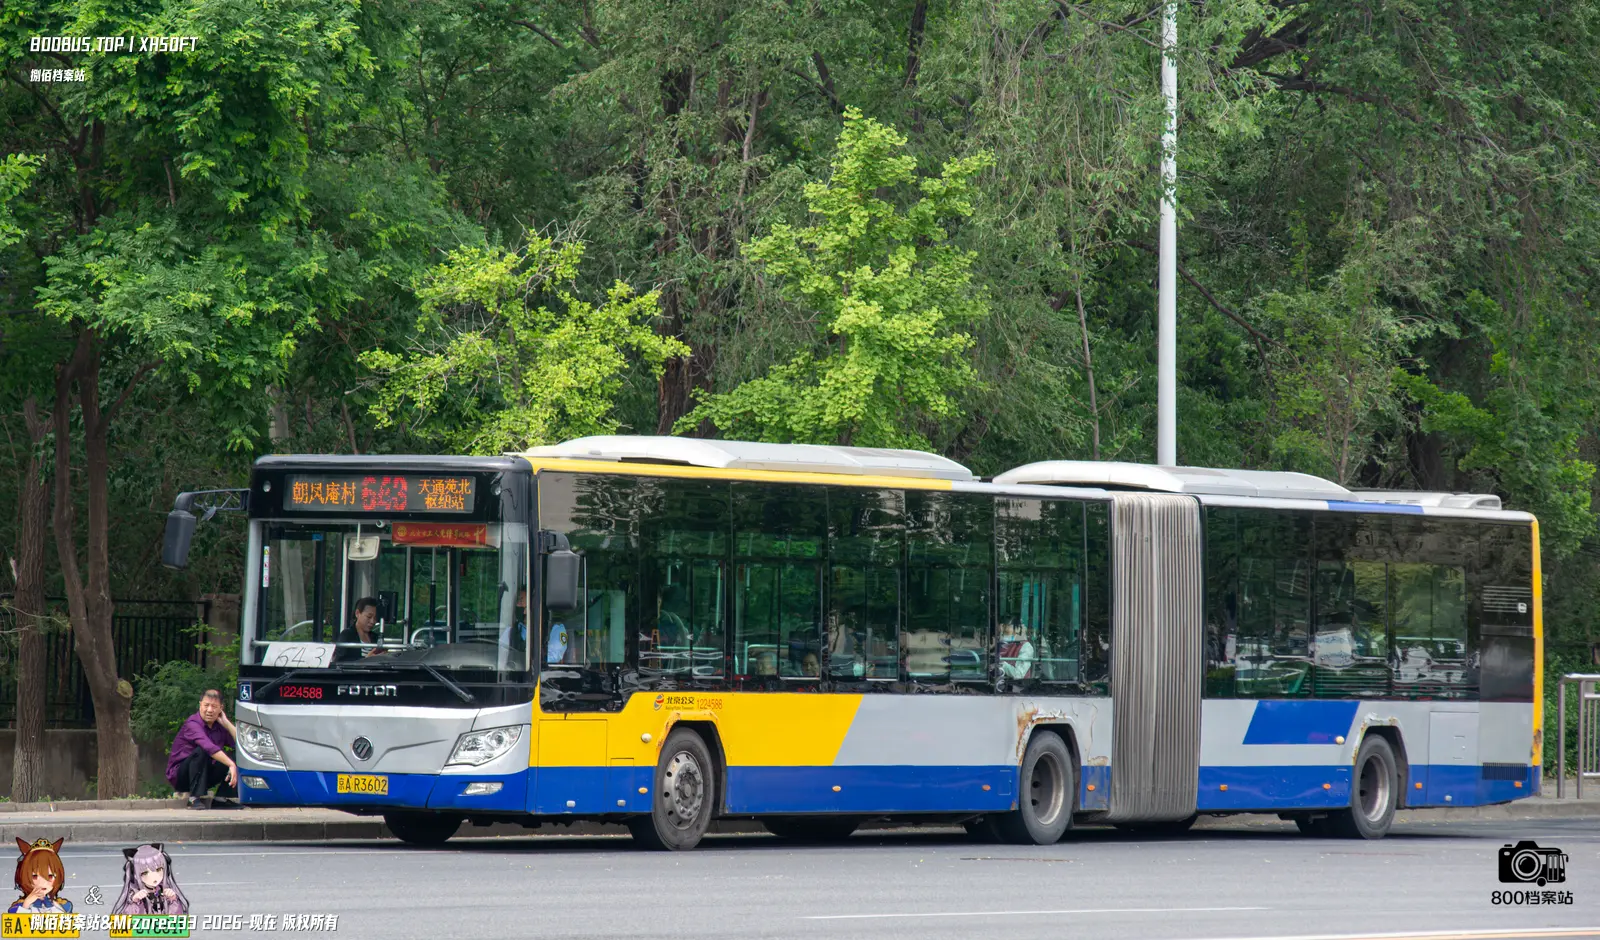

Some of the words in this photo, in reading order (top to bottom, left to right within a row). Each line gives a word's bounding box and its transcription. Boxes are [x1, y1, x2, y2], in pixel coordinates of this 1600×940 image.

[292, 481, 357, 505] 朝凤庵村
[361, 476, 408, 511] 643
[417, 479, 472, 495] 天通苑北
[274, 646, 327, 668] 643
[279, 686, 323, 699] 1224588
[337, 685, 398, 697] FOTON
[666, 696, 695, 705] 北京公交
[696, 698, 723, 710] 1224588
